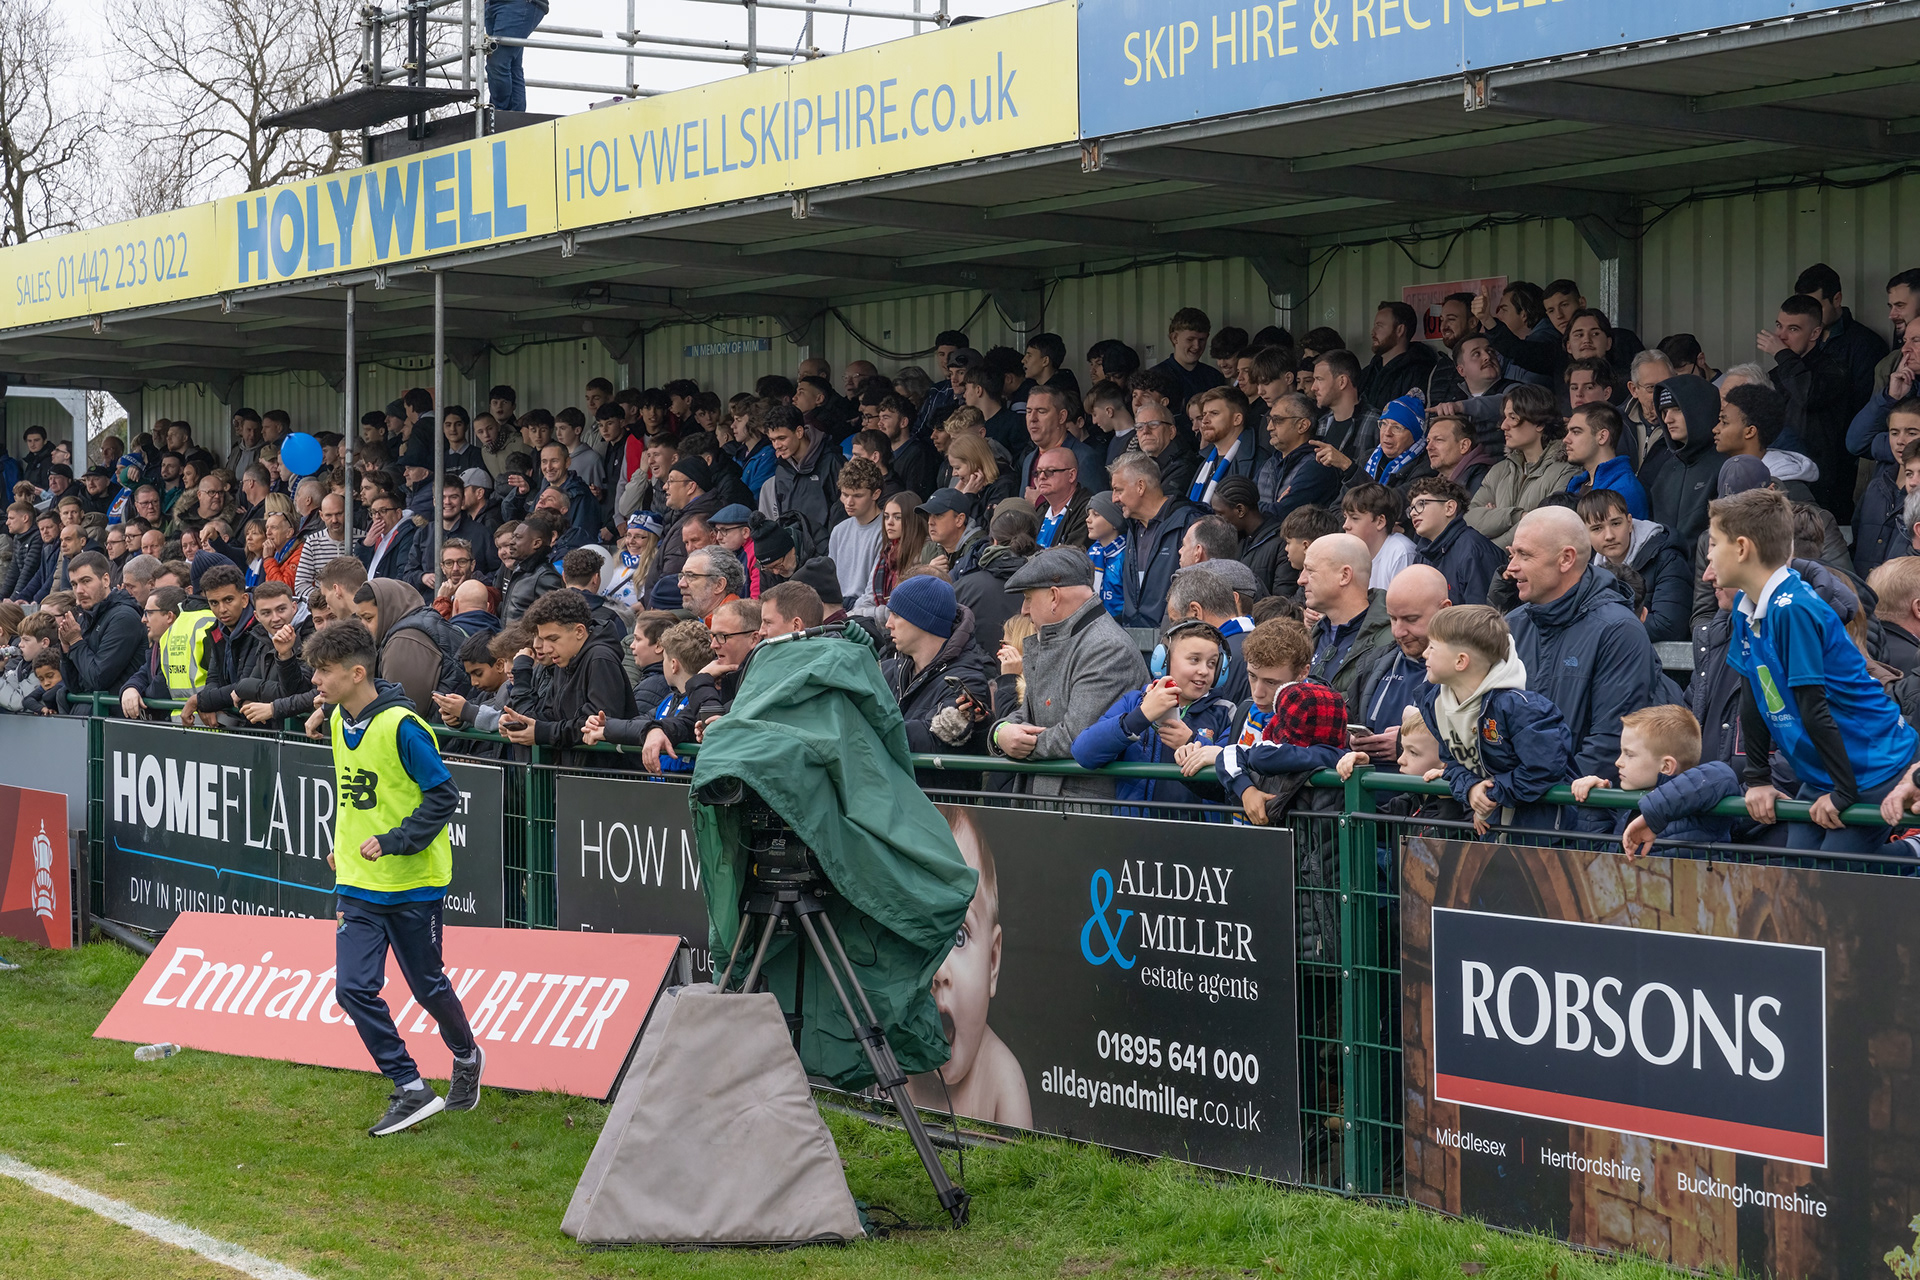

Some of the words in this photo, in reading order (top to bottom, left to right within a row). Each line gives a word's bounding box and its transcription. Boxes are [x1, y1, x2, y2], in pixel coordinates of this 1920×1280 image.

[1123, 20, 1199, 86] SKIP
[1212, 0, 1298, 69] HIRE
[1310, 0, 1339, 50] &
[565, 51, 1019, 202] HOLYWELLSKIPHIRE.co.uk
[236, 140, 528, 284] HOLYWELL
[16, 270, 51, 306] SALES
[57, 247, 110, 299] 01442
[115, 240, 148, 289] 233
[153, 231, 189, 282] 022
[691, 345, 699, 357] IN
[700, 342, 731, 356] MEMORY
[731, 341, 741, 354] OF
[742, 339, 759, 352] MIM
[580, 819, 668, 887] HOW
[1116, 859, 1234, 906] ALLDAY
[130, 876, 151, 905] DIY
[156, 882, 169, 910] IN
[1080, 868, 1137, 970] &
[1138, 912, 1257, 963] MILLER
[471, 971, 630, 1051] BETTER
[1140, 965, 1194, 993] estate
[1198, 976, 1259, 1004] agents
[1461, 960, 1786, 1082] ROBSONS
[1097, 1029, 1162, 1068] 01895
[1168, 1041, 1207, 1076] 641
[1213, 1048, 1260, 1085] 000
[1041, 1065, 1262, 1133] alldayandmiller.co.uk
[1436, 1126, 1507, 1158] Middlesex
[1540, 1146, 1642, 1183] Hertfordshire
[1677, 1171, 1828, 1218] Buckinghamshire
